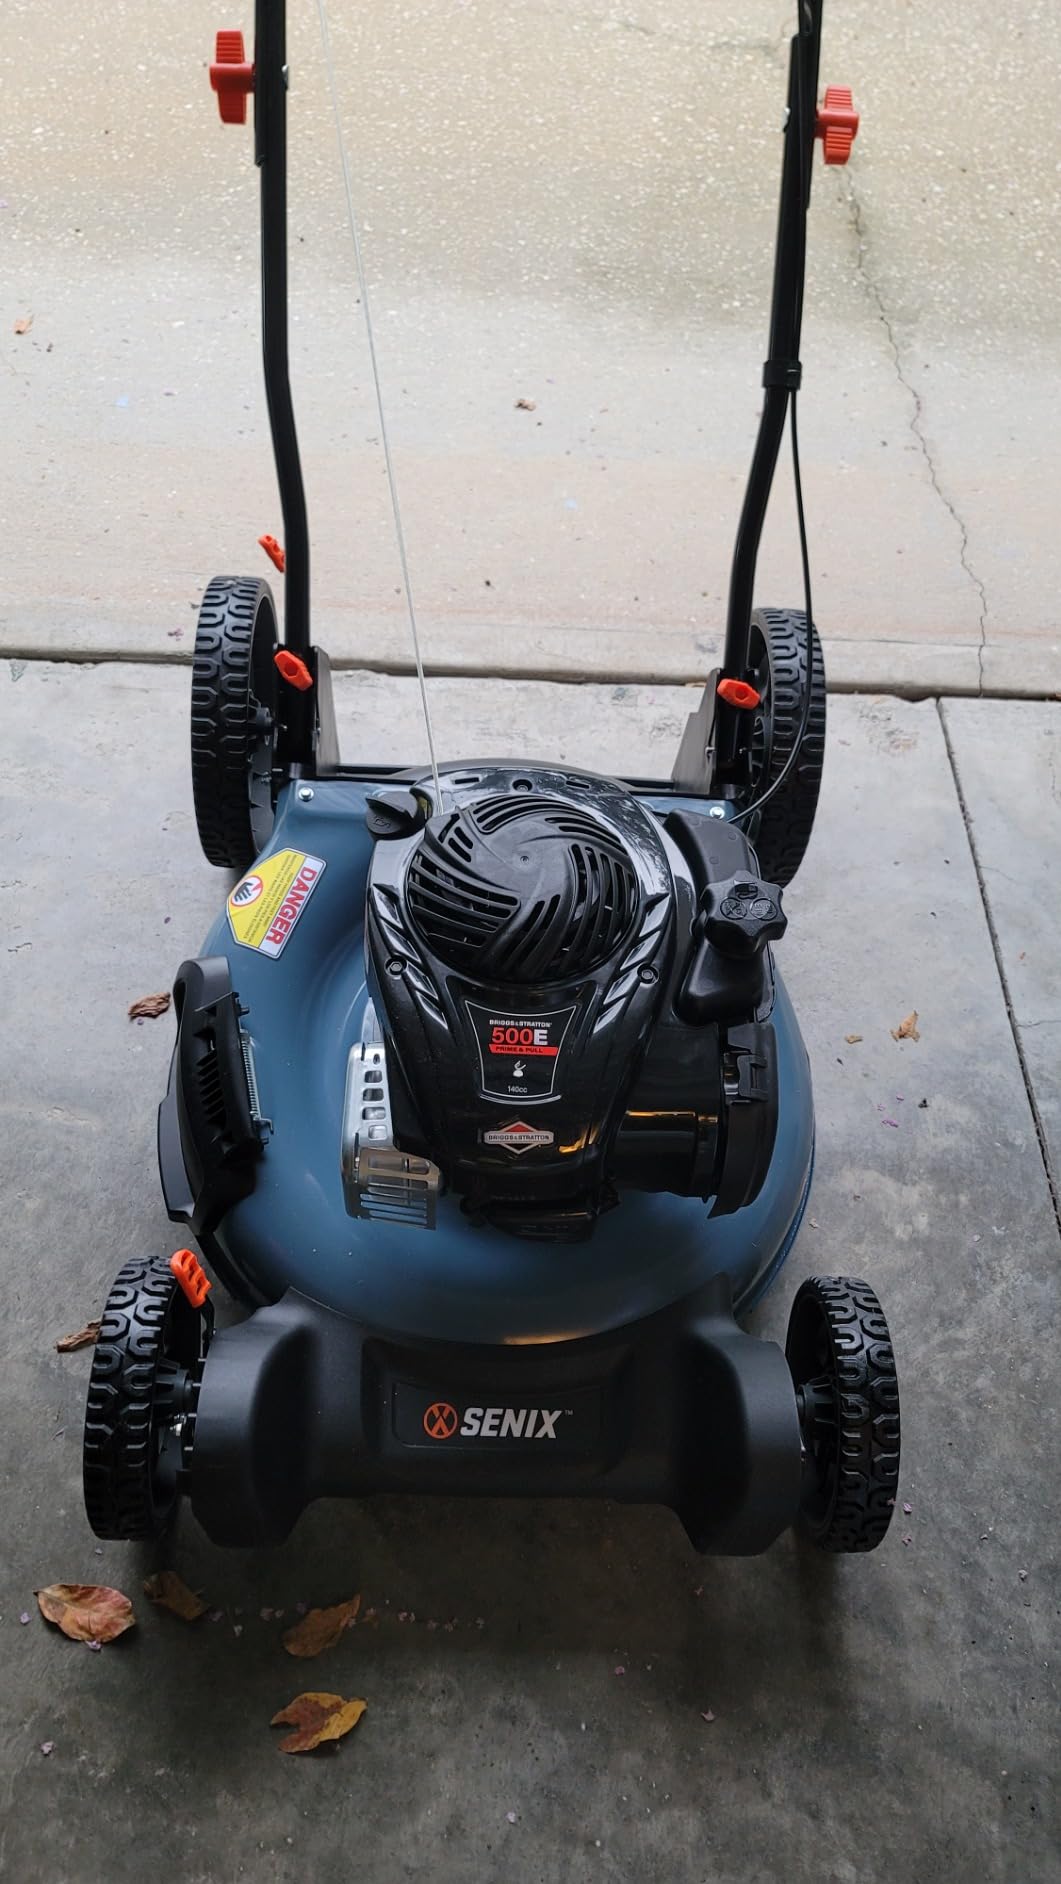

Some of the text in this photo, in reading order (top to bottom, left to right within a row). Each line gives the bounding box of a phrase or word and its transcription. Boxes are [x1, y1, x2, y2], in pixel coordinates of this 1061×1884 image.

[265, 867, 318, 945] DANGER
[491, 1026, 549, 1046] 500E
[507, 1085, 528, 1093] 140cc
[460, 1407, 563, 1439] SENIX
